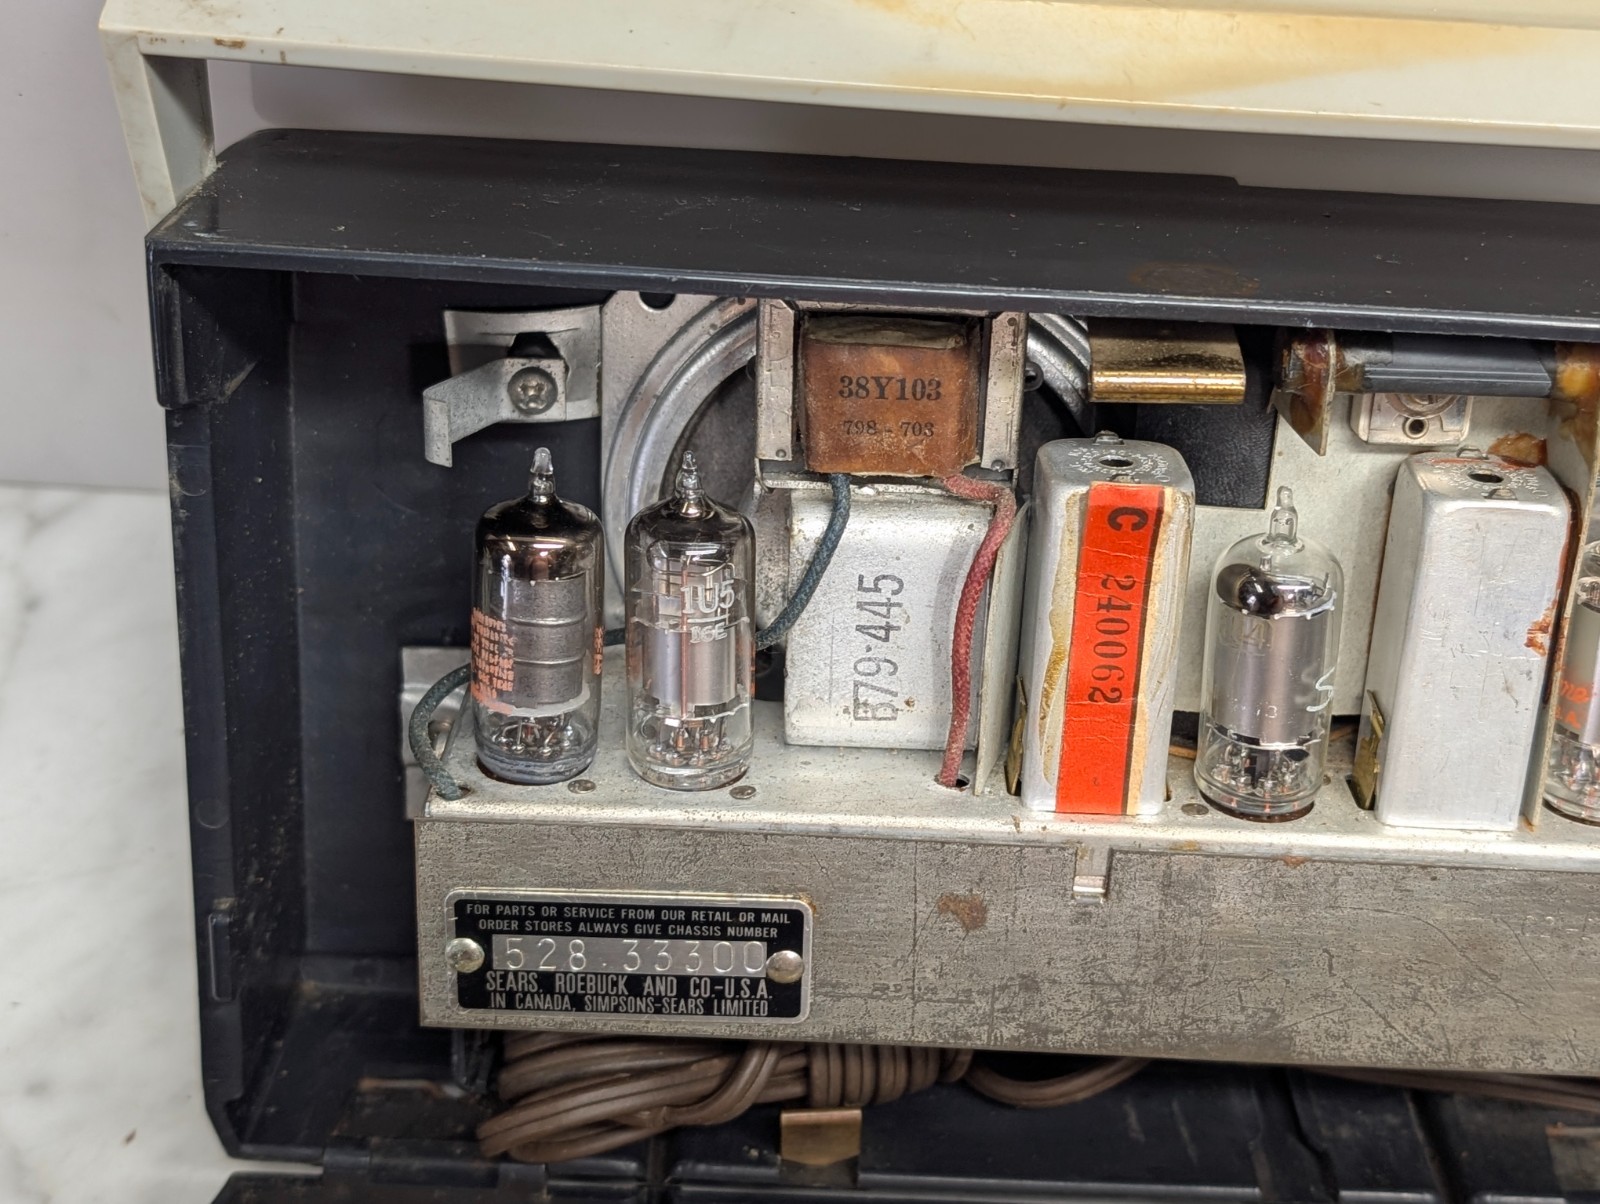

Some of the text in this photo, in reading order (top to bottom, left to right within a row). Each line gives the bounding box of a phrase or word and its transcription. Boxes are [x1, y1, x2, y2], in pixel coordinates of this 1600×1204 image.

[838, 375, 942, 401] 38Y103
[843, 420, 877, 436] 798
[901, 421, 934, 437] 703
[1106, 506, 1149, 532] C
[680, 580, 735, 614] 1U5
[1087, 573, 1137, 704] 240062
[466, 903, 791, 924] FOR PARTS OR SERVICE FROM OUR RETAIL OR MAIL
[478, 918, 778, 938] ORDER STORES ALWAYS GIVE CHASSIS NUMBER
[555, 972, 629, 995] ROEBUCK
[643, 975, 678, 997] AND
[490, 992, 769, 1017] IN CANADA, SIMPSONS-SEARS LIMITED
